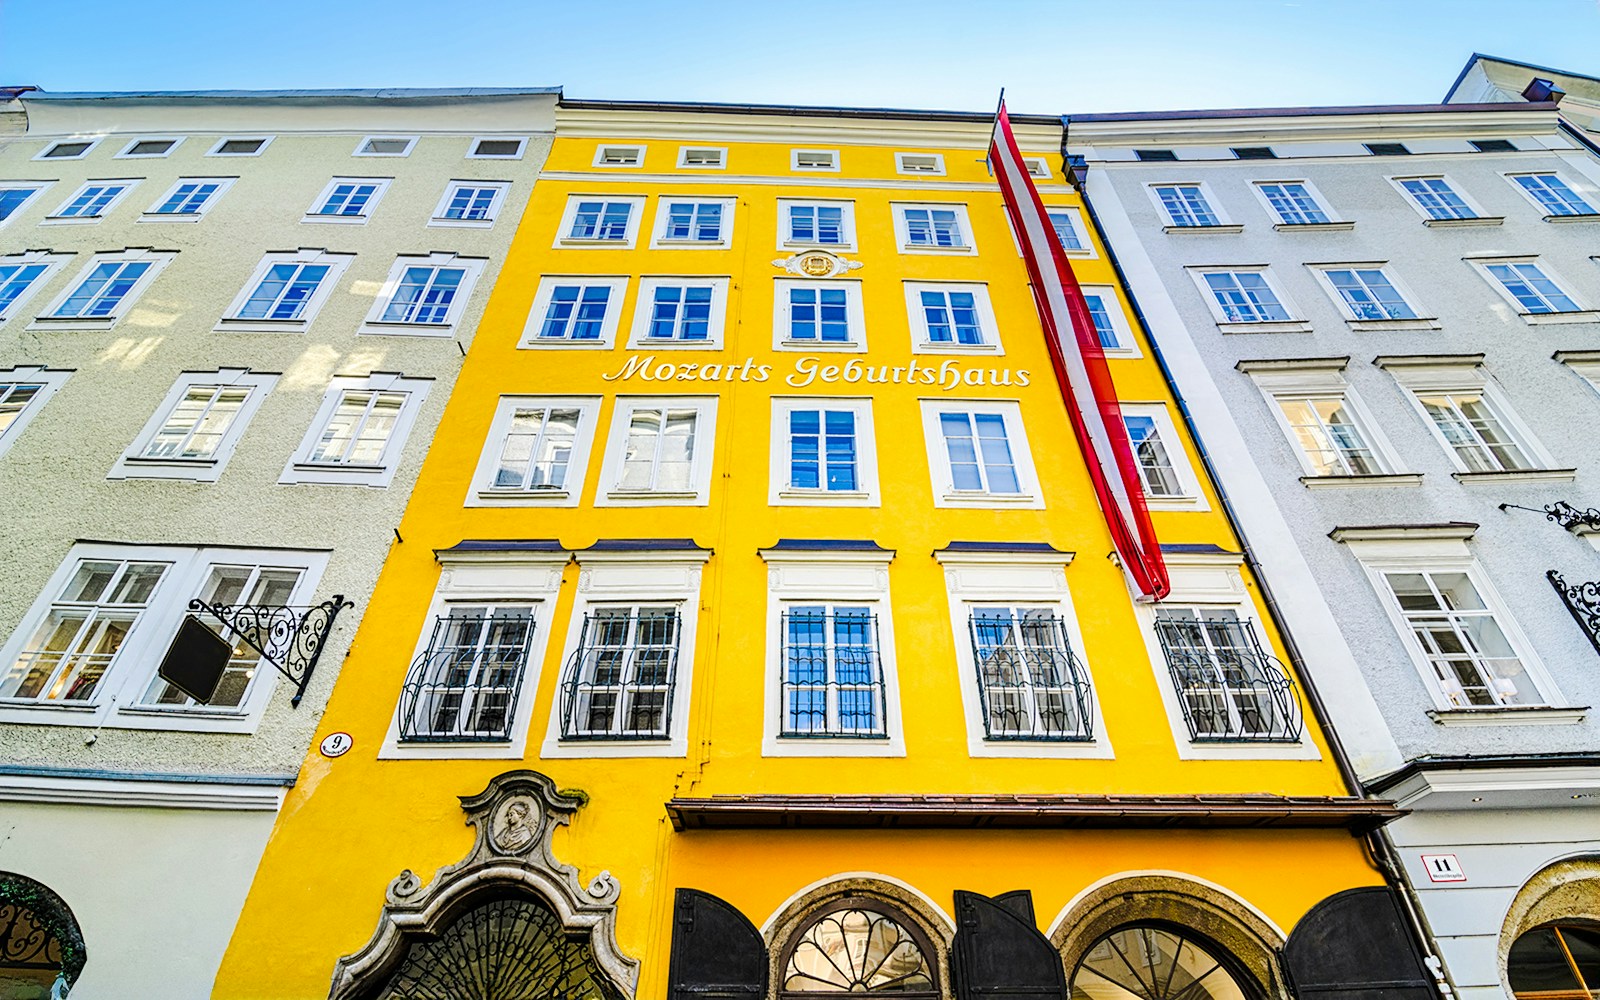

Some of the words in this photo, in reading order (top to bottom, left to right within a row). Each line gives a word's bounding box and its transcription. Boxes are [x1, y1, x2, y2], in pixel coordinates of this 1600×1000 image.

[602, 354, 773, 383] Mozarts
[785, 356, 1031, 391] Geburtshaus
[331, 735, 343, 749] 9
[1433, 858, 1452, 872] 11
